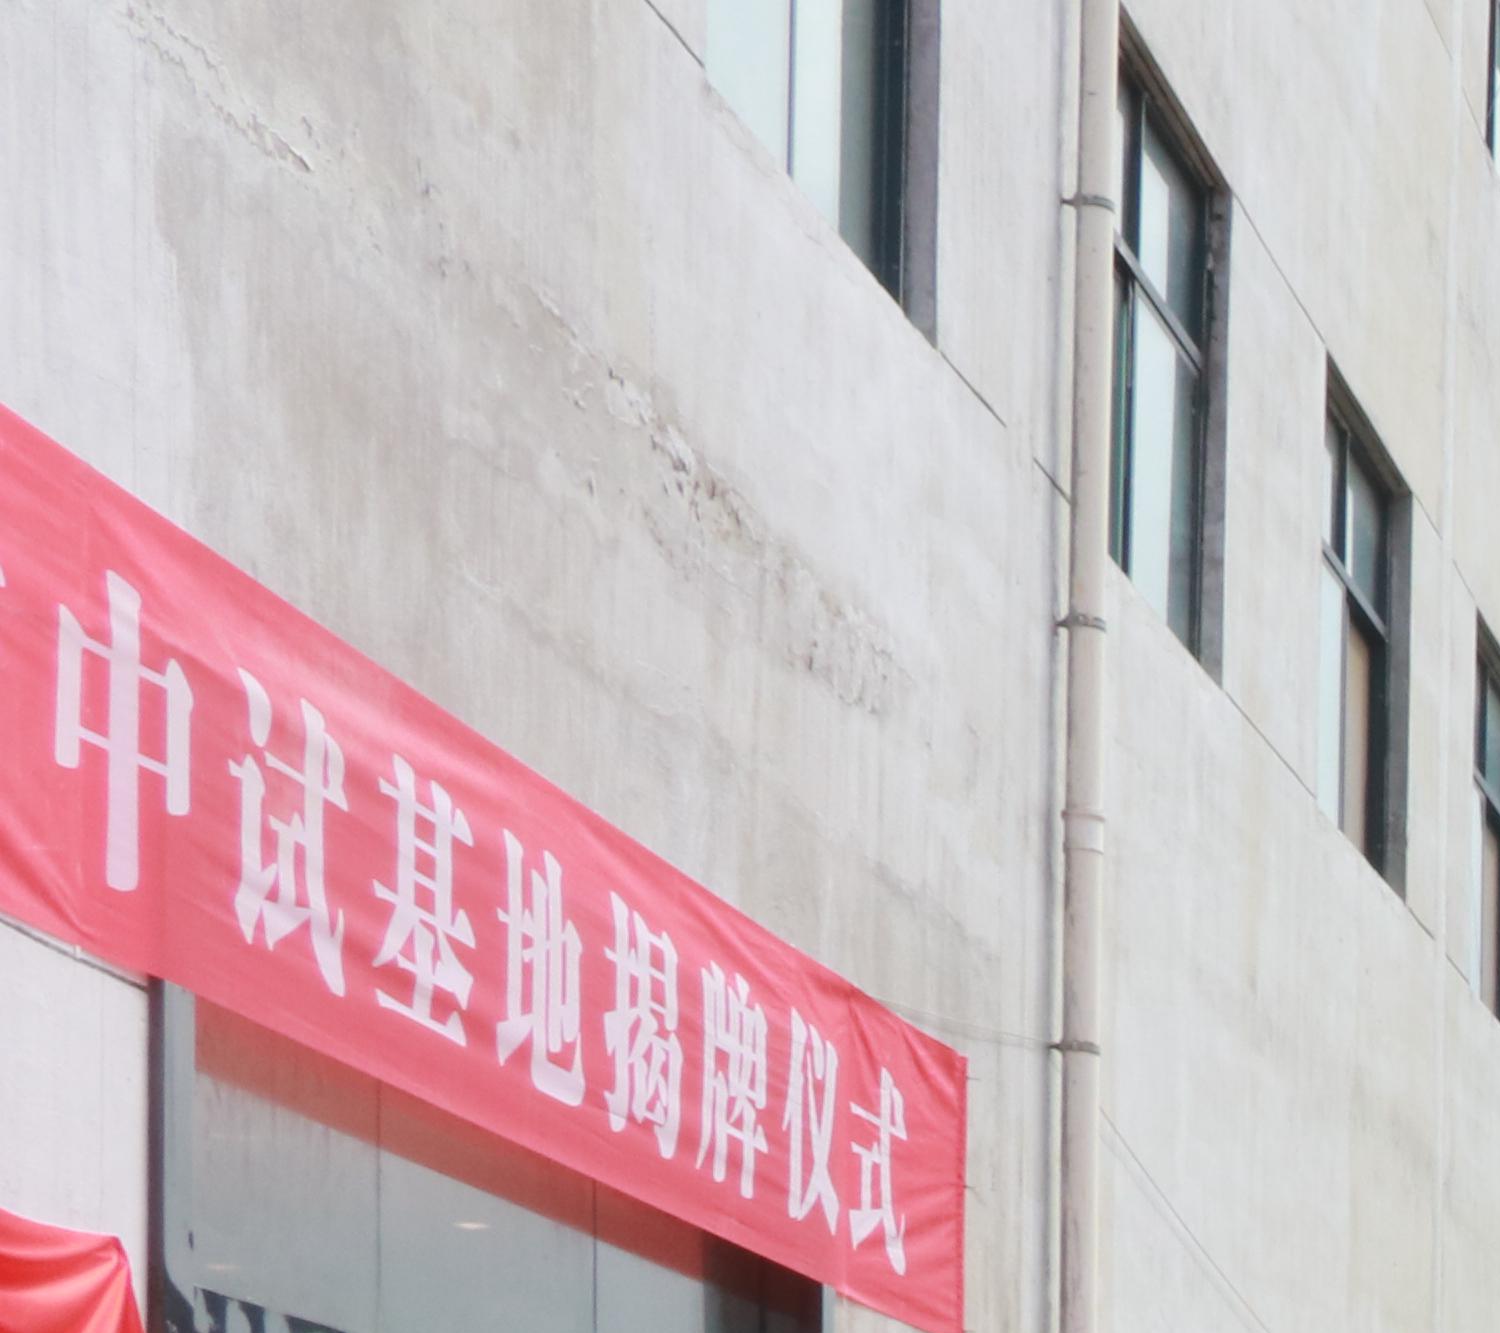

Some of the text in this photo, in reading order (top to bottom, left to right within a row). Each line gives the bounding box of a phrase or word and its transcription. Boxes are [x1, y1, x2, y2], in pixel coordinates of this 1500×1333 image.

[0, 562, 908, 1277] 中试基地揭牌仪式
